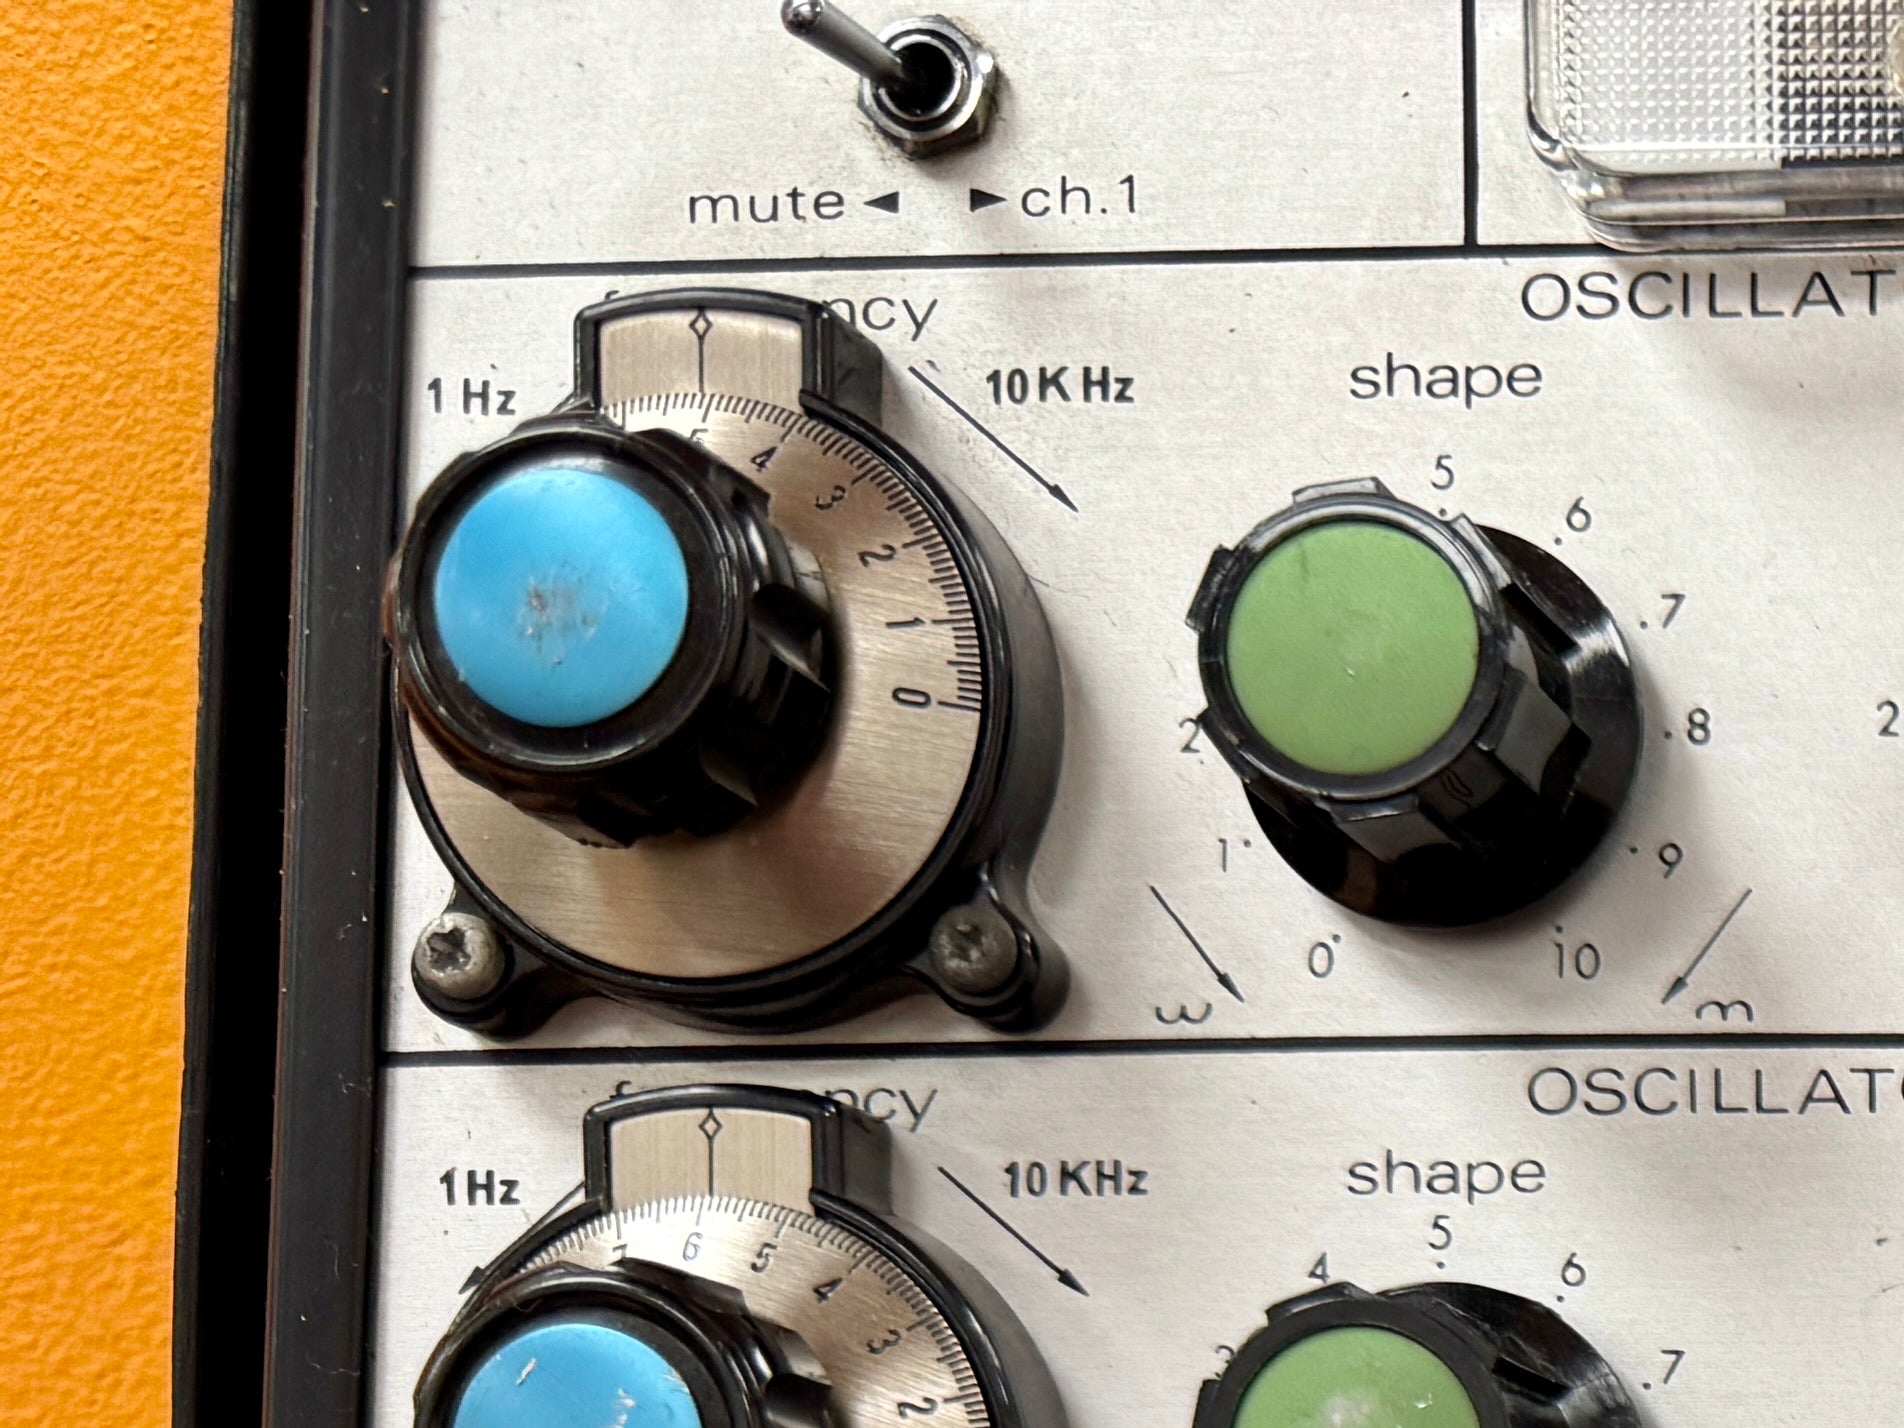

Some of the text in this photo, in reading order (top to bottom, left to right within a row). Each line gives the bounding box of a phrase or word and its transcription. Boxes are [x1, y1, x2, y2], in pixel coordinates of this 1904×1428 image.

[689, 186, 844, 224] mute
[1021, 174, 1135, 217] ch.1
[1350, 352, 1542, 410] shape
[1347, 1149, 1546, 1205] shape
